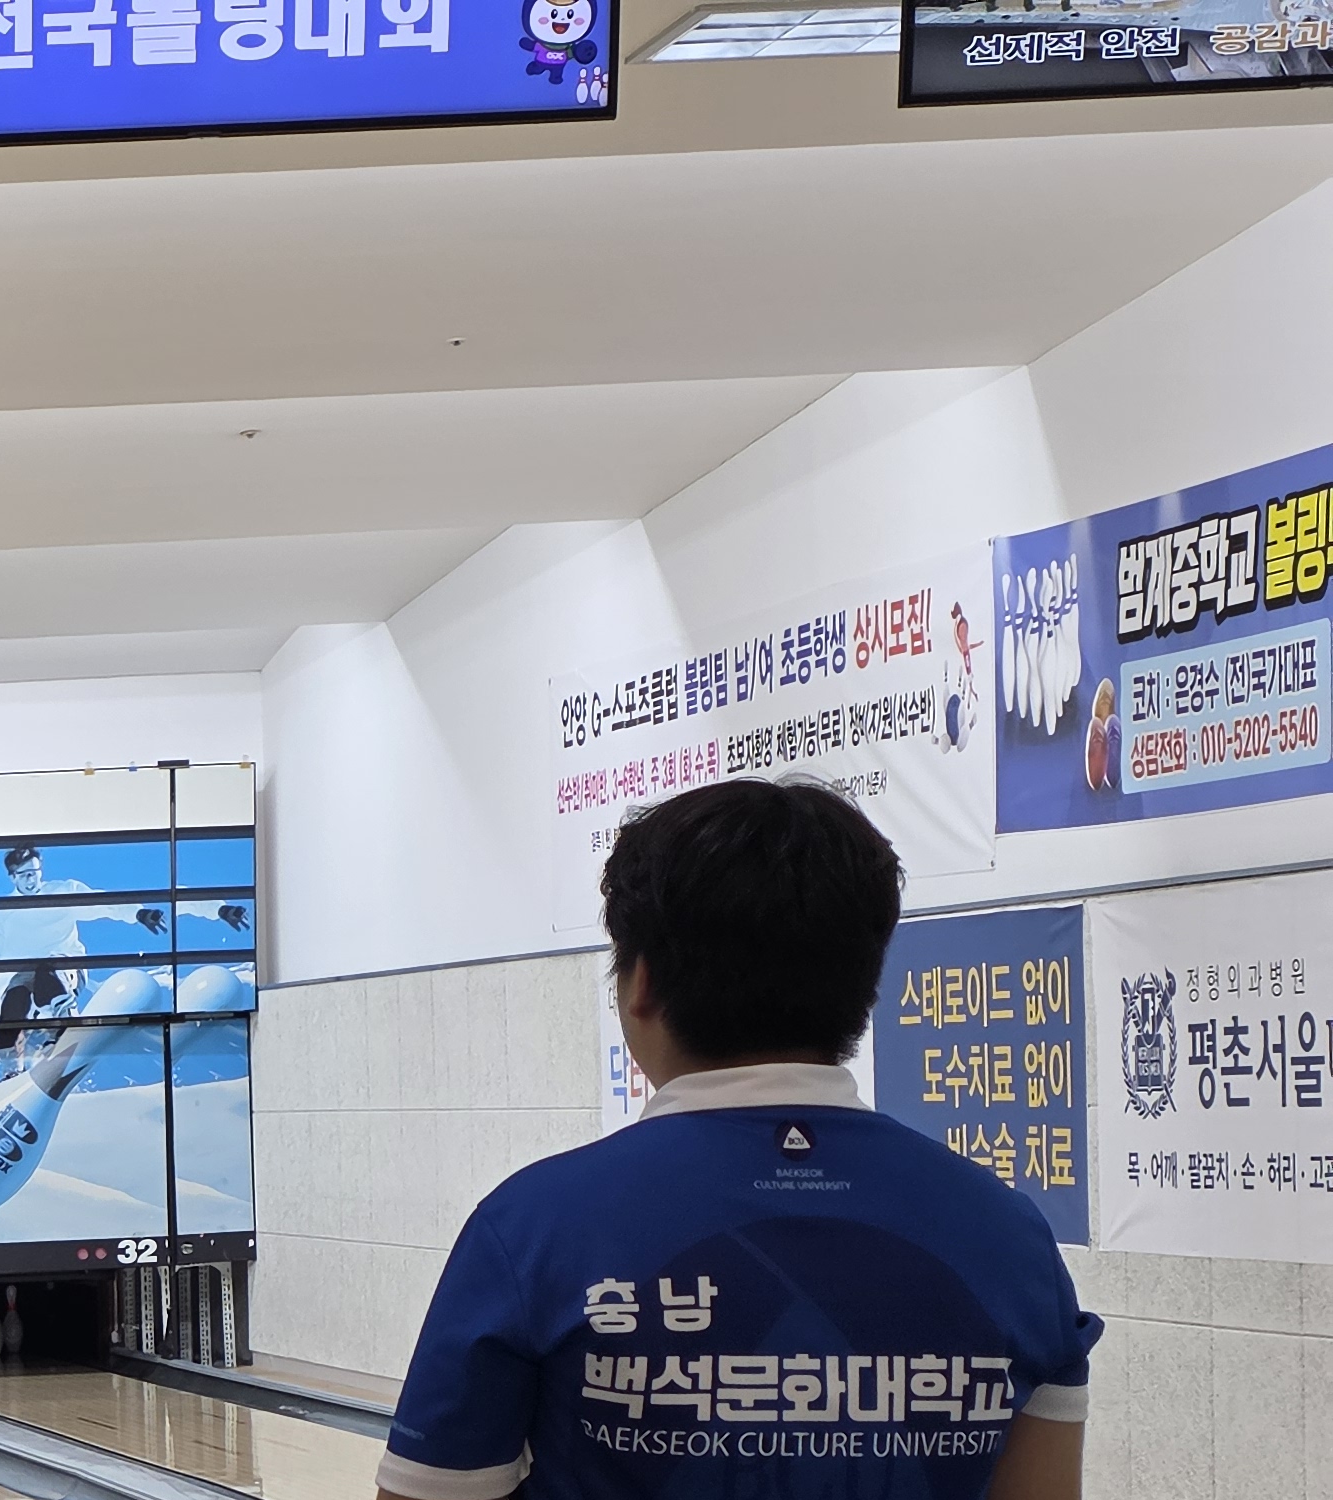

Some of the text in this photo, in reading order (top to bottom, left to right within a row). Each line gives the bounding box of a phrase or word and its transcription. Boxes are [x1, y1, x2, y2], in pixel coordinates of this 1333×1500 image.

[963, 31, 1085, 66] 선제적
[1100, 26, 1181, 60] 안전
[1118, 487, 1333, 634] 범계중학교 볼링
[561, 692, 587, 748] 안양
[684, 648, 728, 717] 볼링팀
[735, 633, 773, 702] 남/여
[780, 610, 846, 687] 초등학생
[853, 588, 932, 669] 상시모집!
[1175, 661, 1220, 715] 은경수
[727, 725, 774, 774] 초보자환영
[1201, 705, 1319, 767] 010-5202-5540
[899, 956, 1071, 1029] 스테로이드 없이
[923, 1045, 1016, 1108] 도수치료
[1024, 1041, 1073, 1108] 없이
[1188, 1011, 1333, 1109] 평촌서울
[1024, 1123, 1076, 1191] 치료
[117, 1239, 159, 1265] 32
[581, 1352, 1016, 1422] 백석문화대학교
[580, 1418, 1003, 1458] BAEKSEOK CULTURE UNIVERSIT
